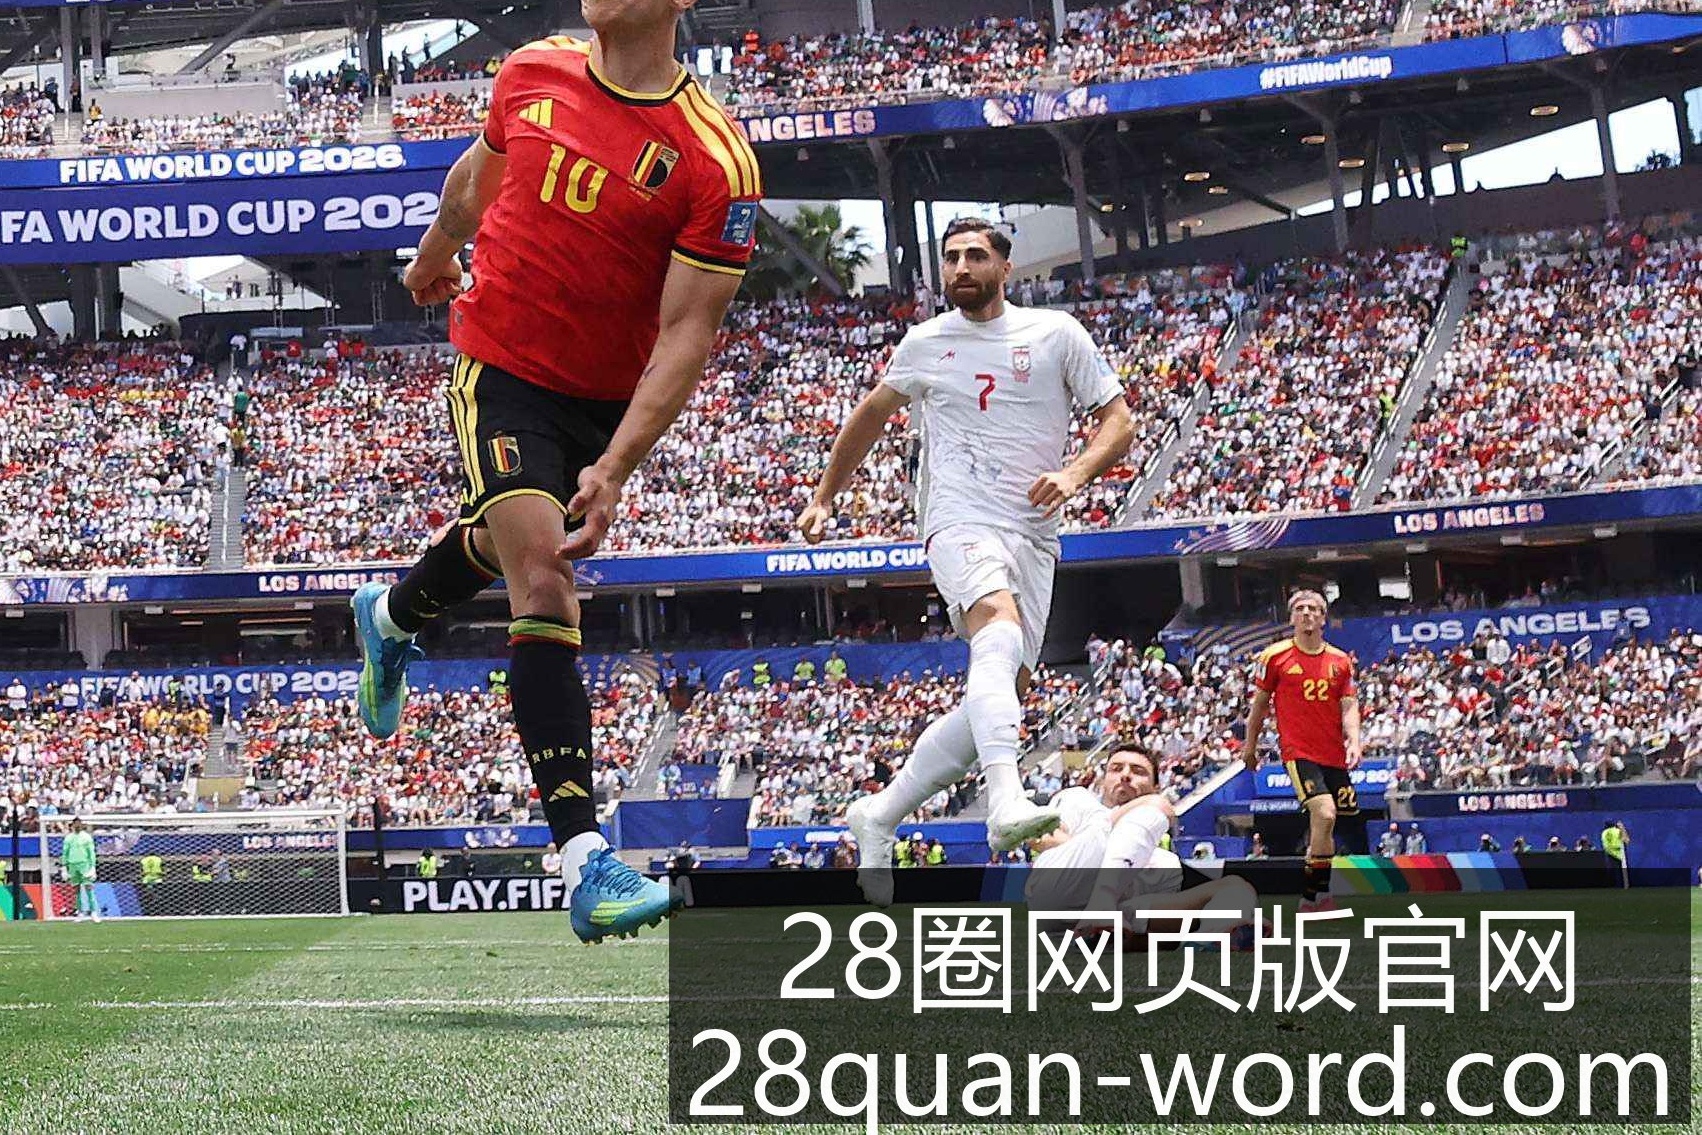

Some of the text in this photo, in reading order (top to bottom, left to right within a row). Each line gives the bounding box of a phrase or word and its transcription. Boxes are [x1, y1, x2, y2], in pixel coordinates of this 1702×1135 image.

[1260, 56, 1392, 89] #FIFAWorldCup
[60, 145, 403, 183] FIFA WORLD CUP 2026
[540, 142, 609, 214] 10
[58, 204, 219, 242] WORLD
[227, 199, 316, 234] CUP
[975, 374, 995, 411] 7
[1394, 503, 1545, 534] LOS ANGELES
[766, 553, 811, 572] FIFA
[811, 550, 887, 571] WORLD
[258, 575, 300, 592] LOS
[1391, 619, 1464, 644] LOS
[1303, 678, 1329, 701] 22
[1459, 792, 1567, 811] LOS ANGELES
